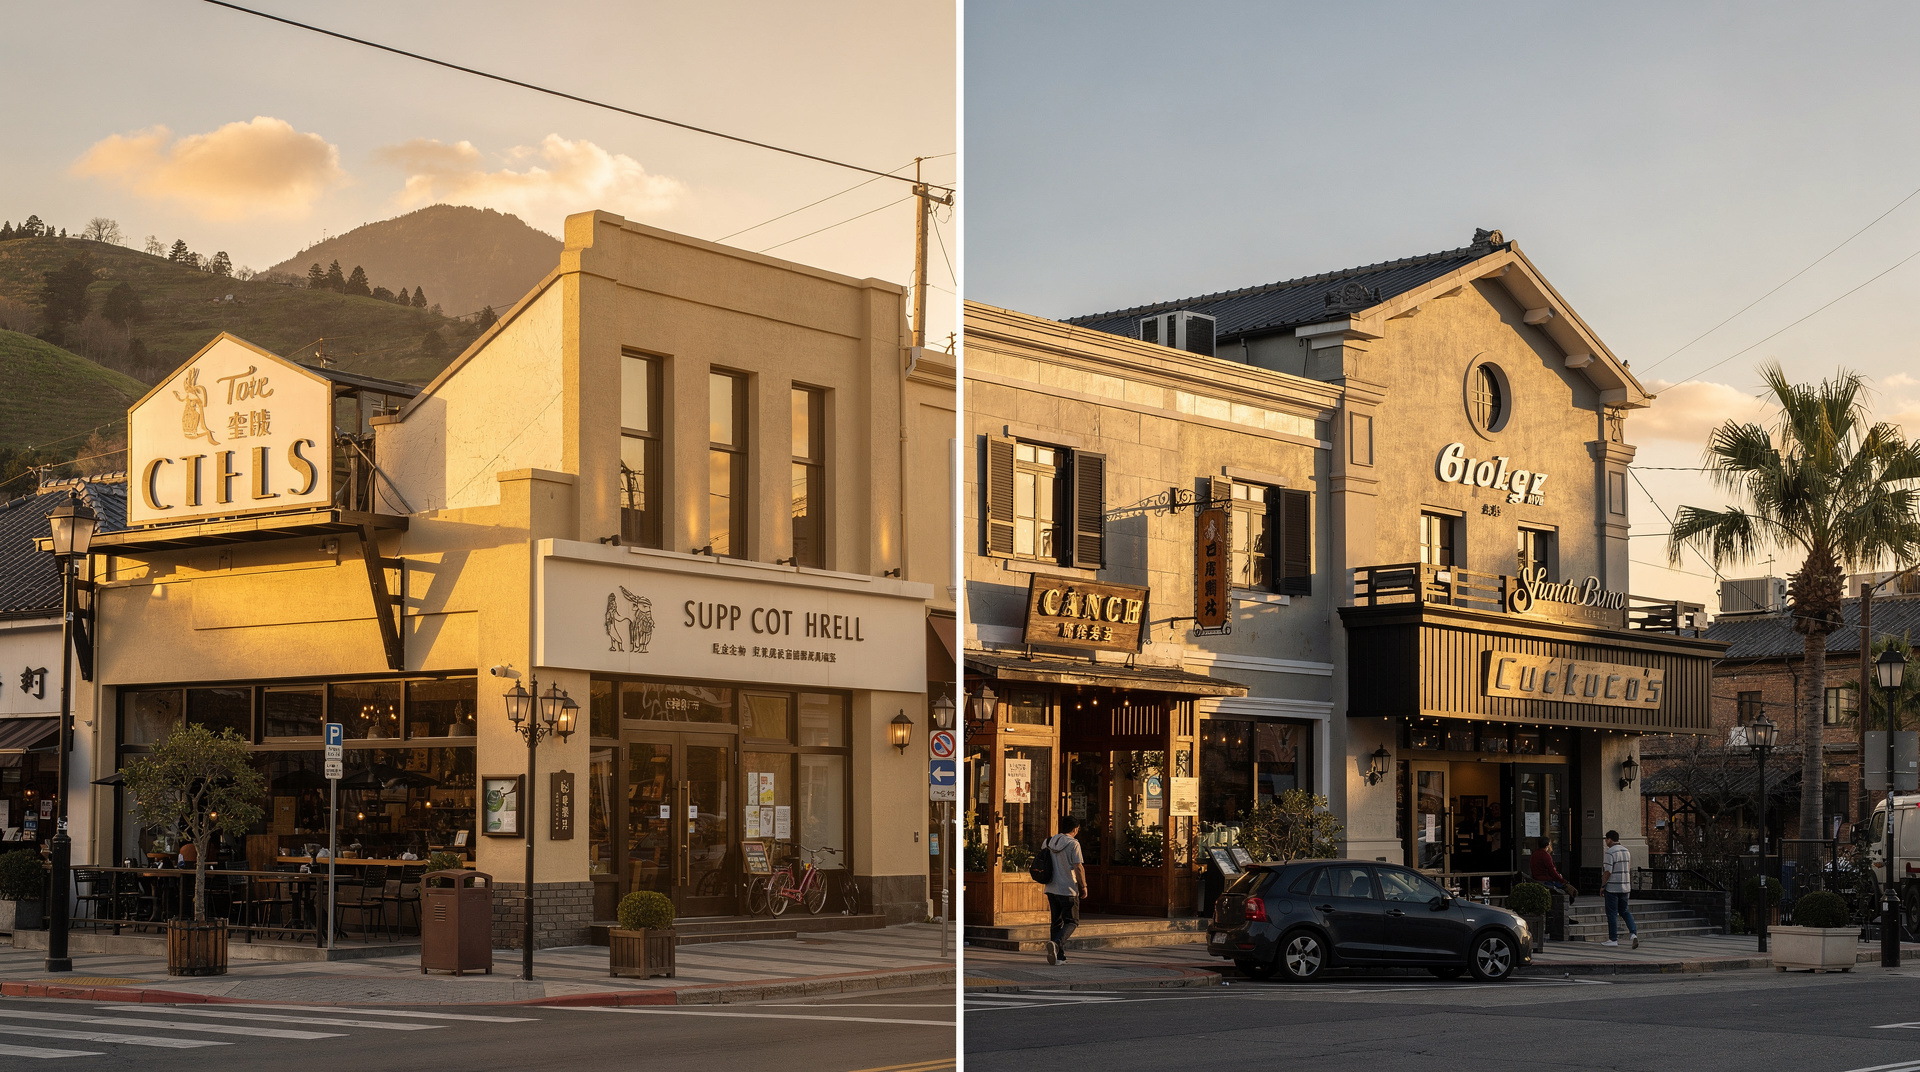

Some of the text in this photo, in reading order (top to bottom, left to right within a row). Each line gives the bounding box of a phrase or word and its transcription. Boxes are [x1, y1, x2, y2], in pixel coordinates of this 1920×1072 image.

[684, 600, 865, 642] SUPP COT HRELL
[330, 726, 340, 745] P
